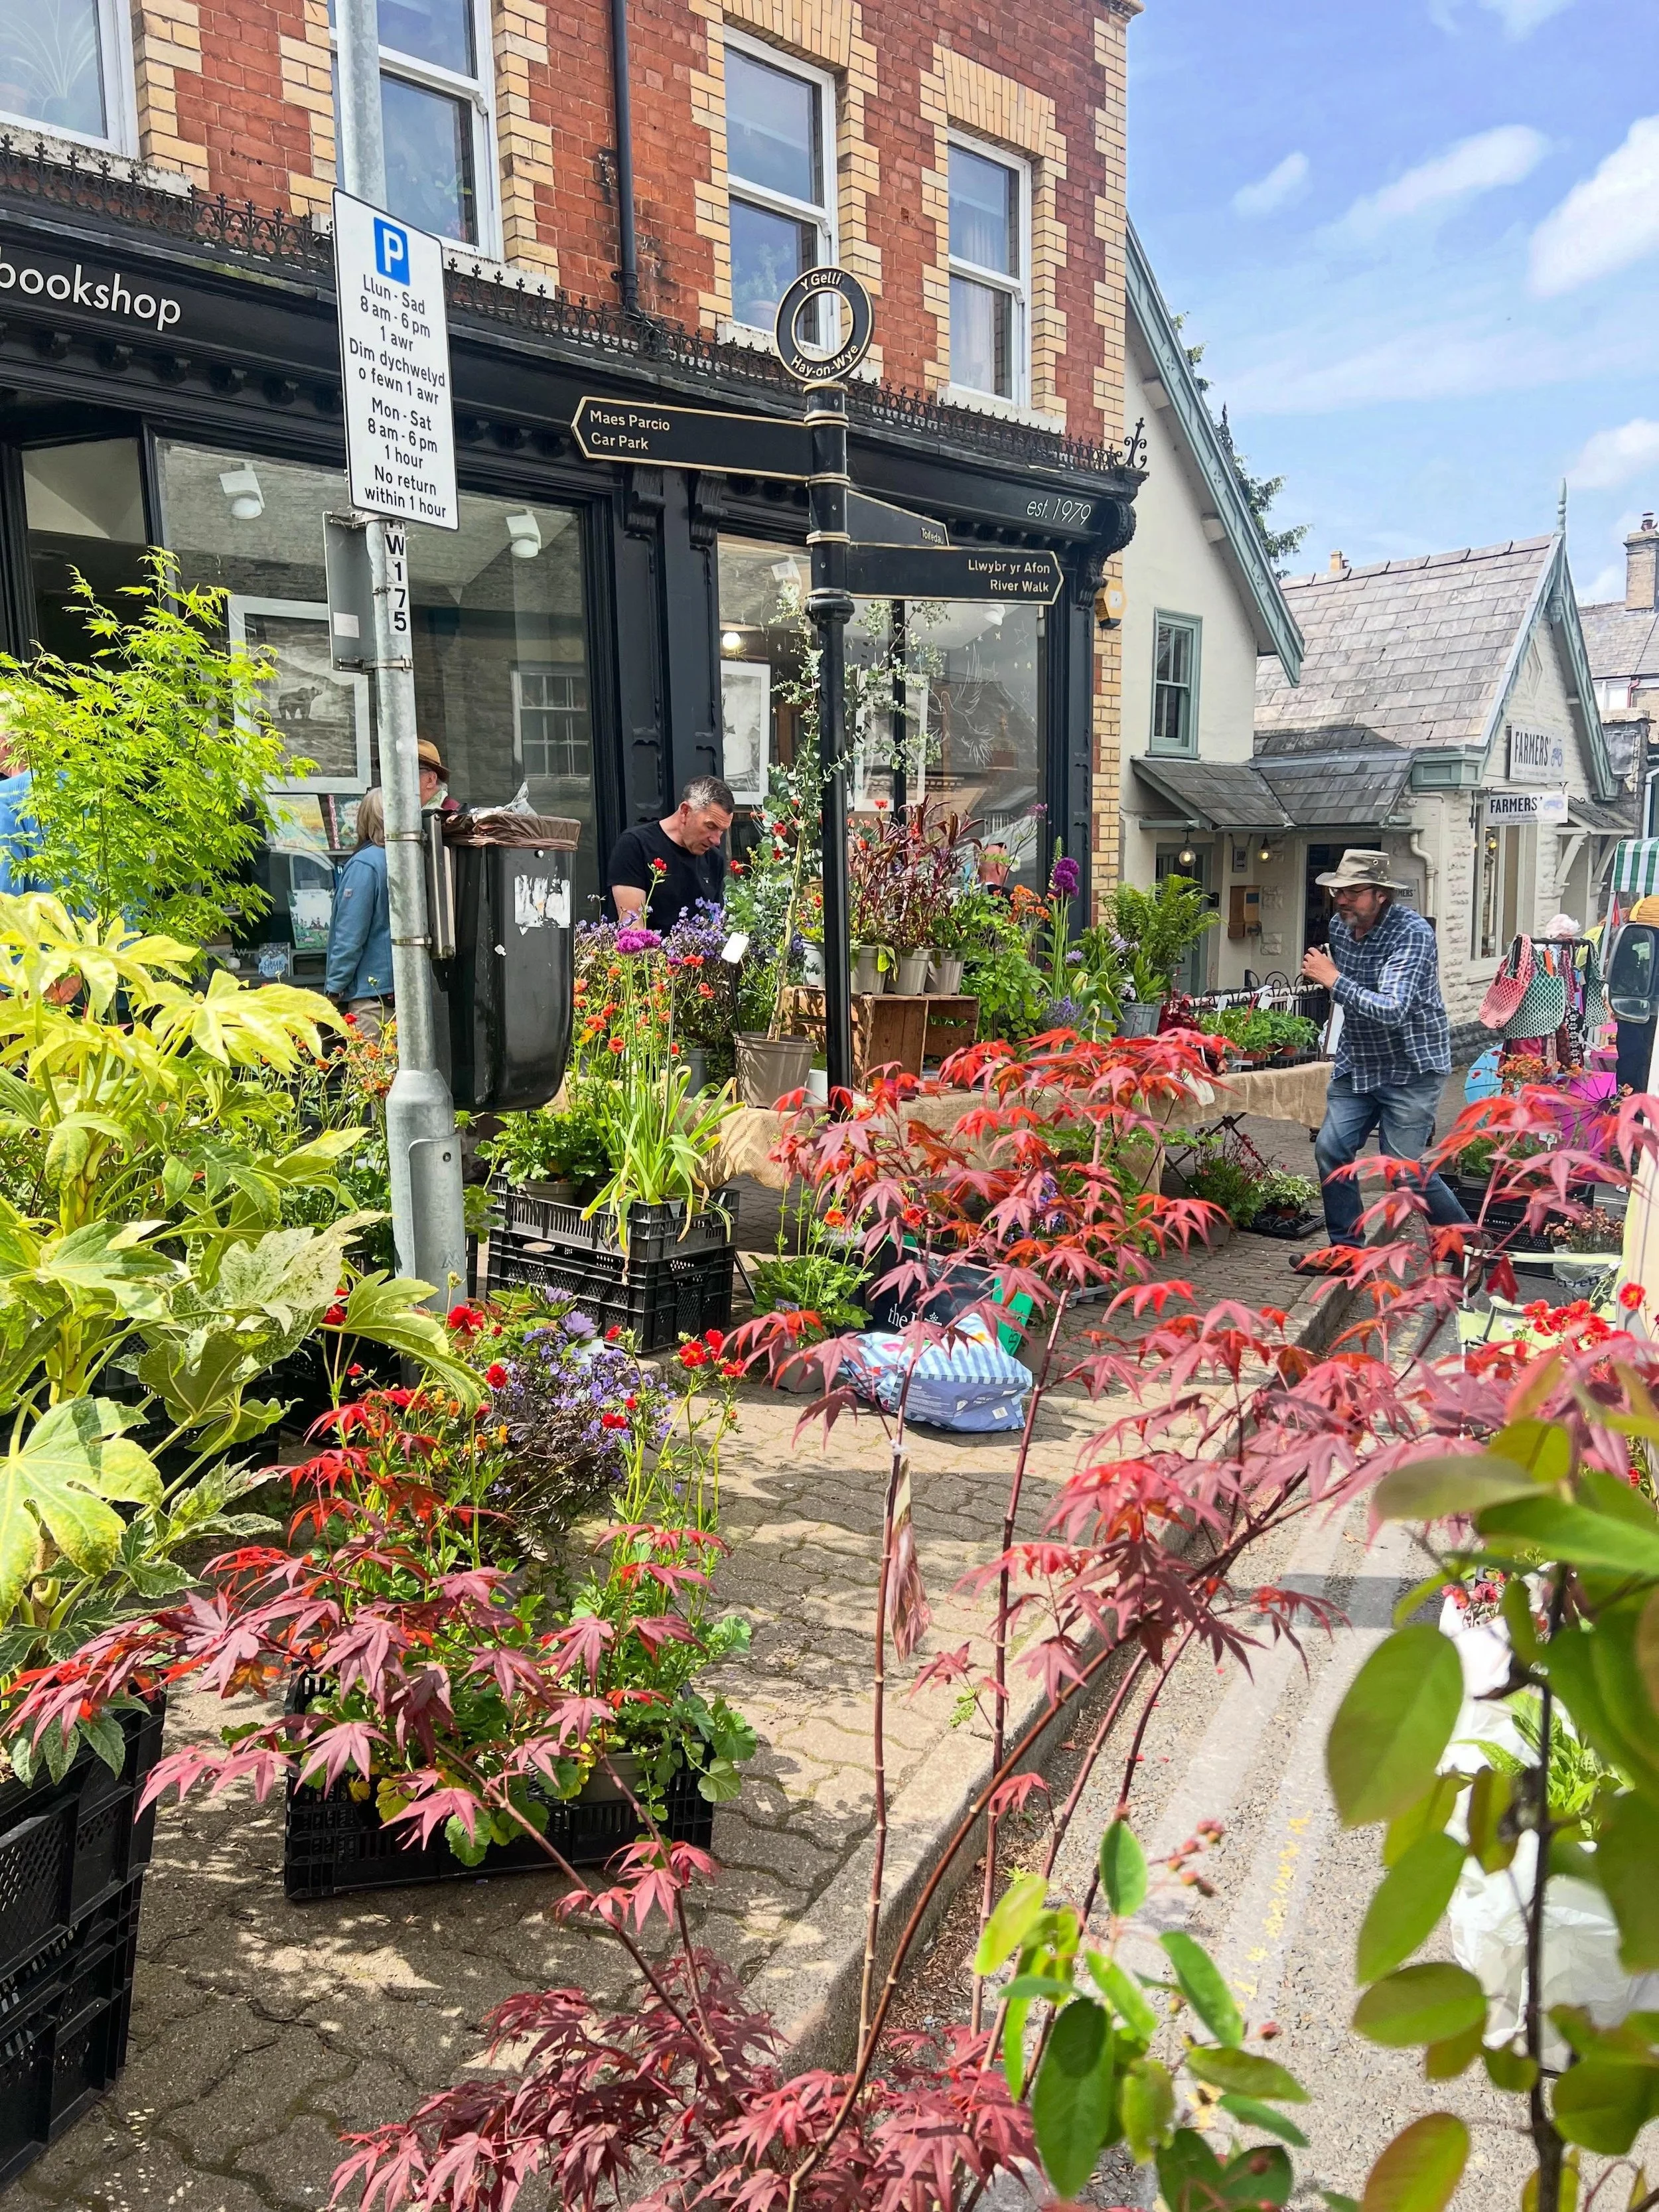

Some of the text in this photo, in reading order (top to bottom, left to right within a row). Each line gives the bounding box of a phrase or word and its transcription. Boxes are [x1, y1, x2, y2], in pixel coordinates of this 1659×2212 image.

[383, 228, 404, 273] P
[0, 246, 181, 331] bookshop
[362, 274, 391, 301] Llun
[401, 291, 425, 315] Sad
[800, 271, 842, 291] Y Gelli
[380, 325, 413, 352] 1 awr
[349, 337, 445, 388] Dim dychwelyd
[790, 344, 859, 377] Hay-on-Wye
[359, 367, 439, 405] o fewn 1 awr
[372, 397, 399, 421] Mon
[410, 410, 432, 431] Sat
[590, 409, 670, 431] Maes Parcio
[591, 432, 649, 450] Car Park
[385, 444, 423, 469] 1 hour
[374, 465, 437, 496] No return
[364, 486, 447, 518] within 1 hour
[1052, 498, 1092, 526] 1979
[968, 559, 1050, 575] Llwybr yr Afon
[990, 579, 1049, 593] River Walk
[1514, 731, 1551, 767] FARMERS'
[1490, 796, 1543, 814] FARMERS'
[887, 1303, 908, 1329] the
